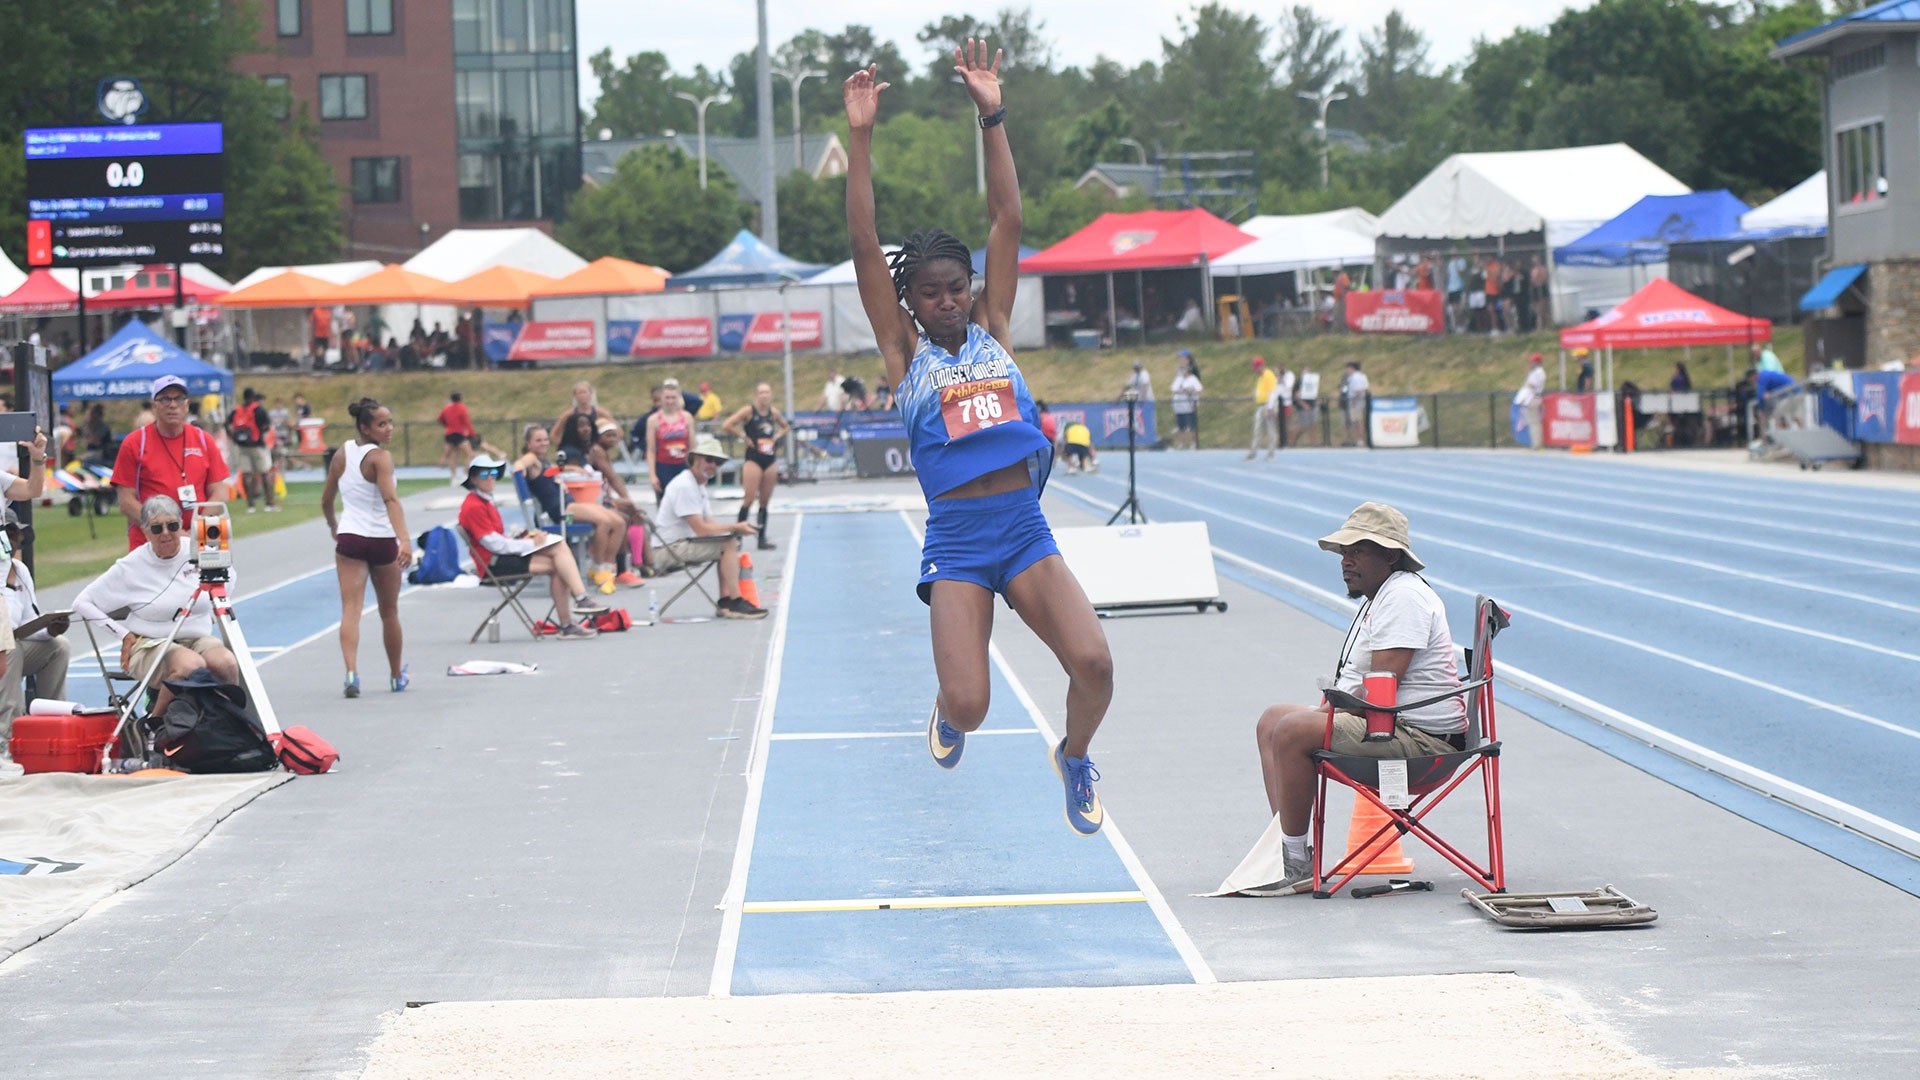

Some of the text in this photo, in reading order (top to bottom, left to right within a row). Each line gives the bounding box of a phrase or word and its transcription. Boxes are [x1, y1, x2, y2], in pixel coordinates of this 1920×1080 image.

[106, 162, 144, 188] 0.0
[72, 380, 153, 397] UNC ASHEV
[929, 359, 1009, 390] LINDSEY WILSON
[958, 393, 1003, 423] 786
